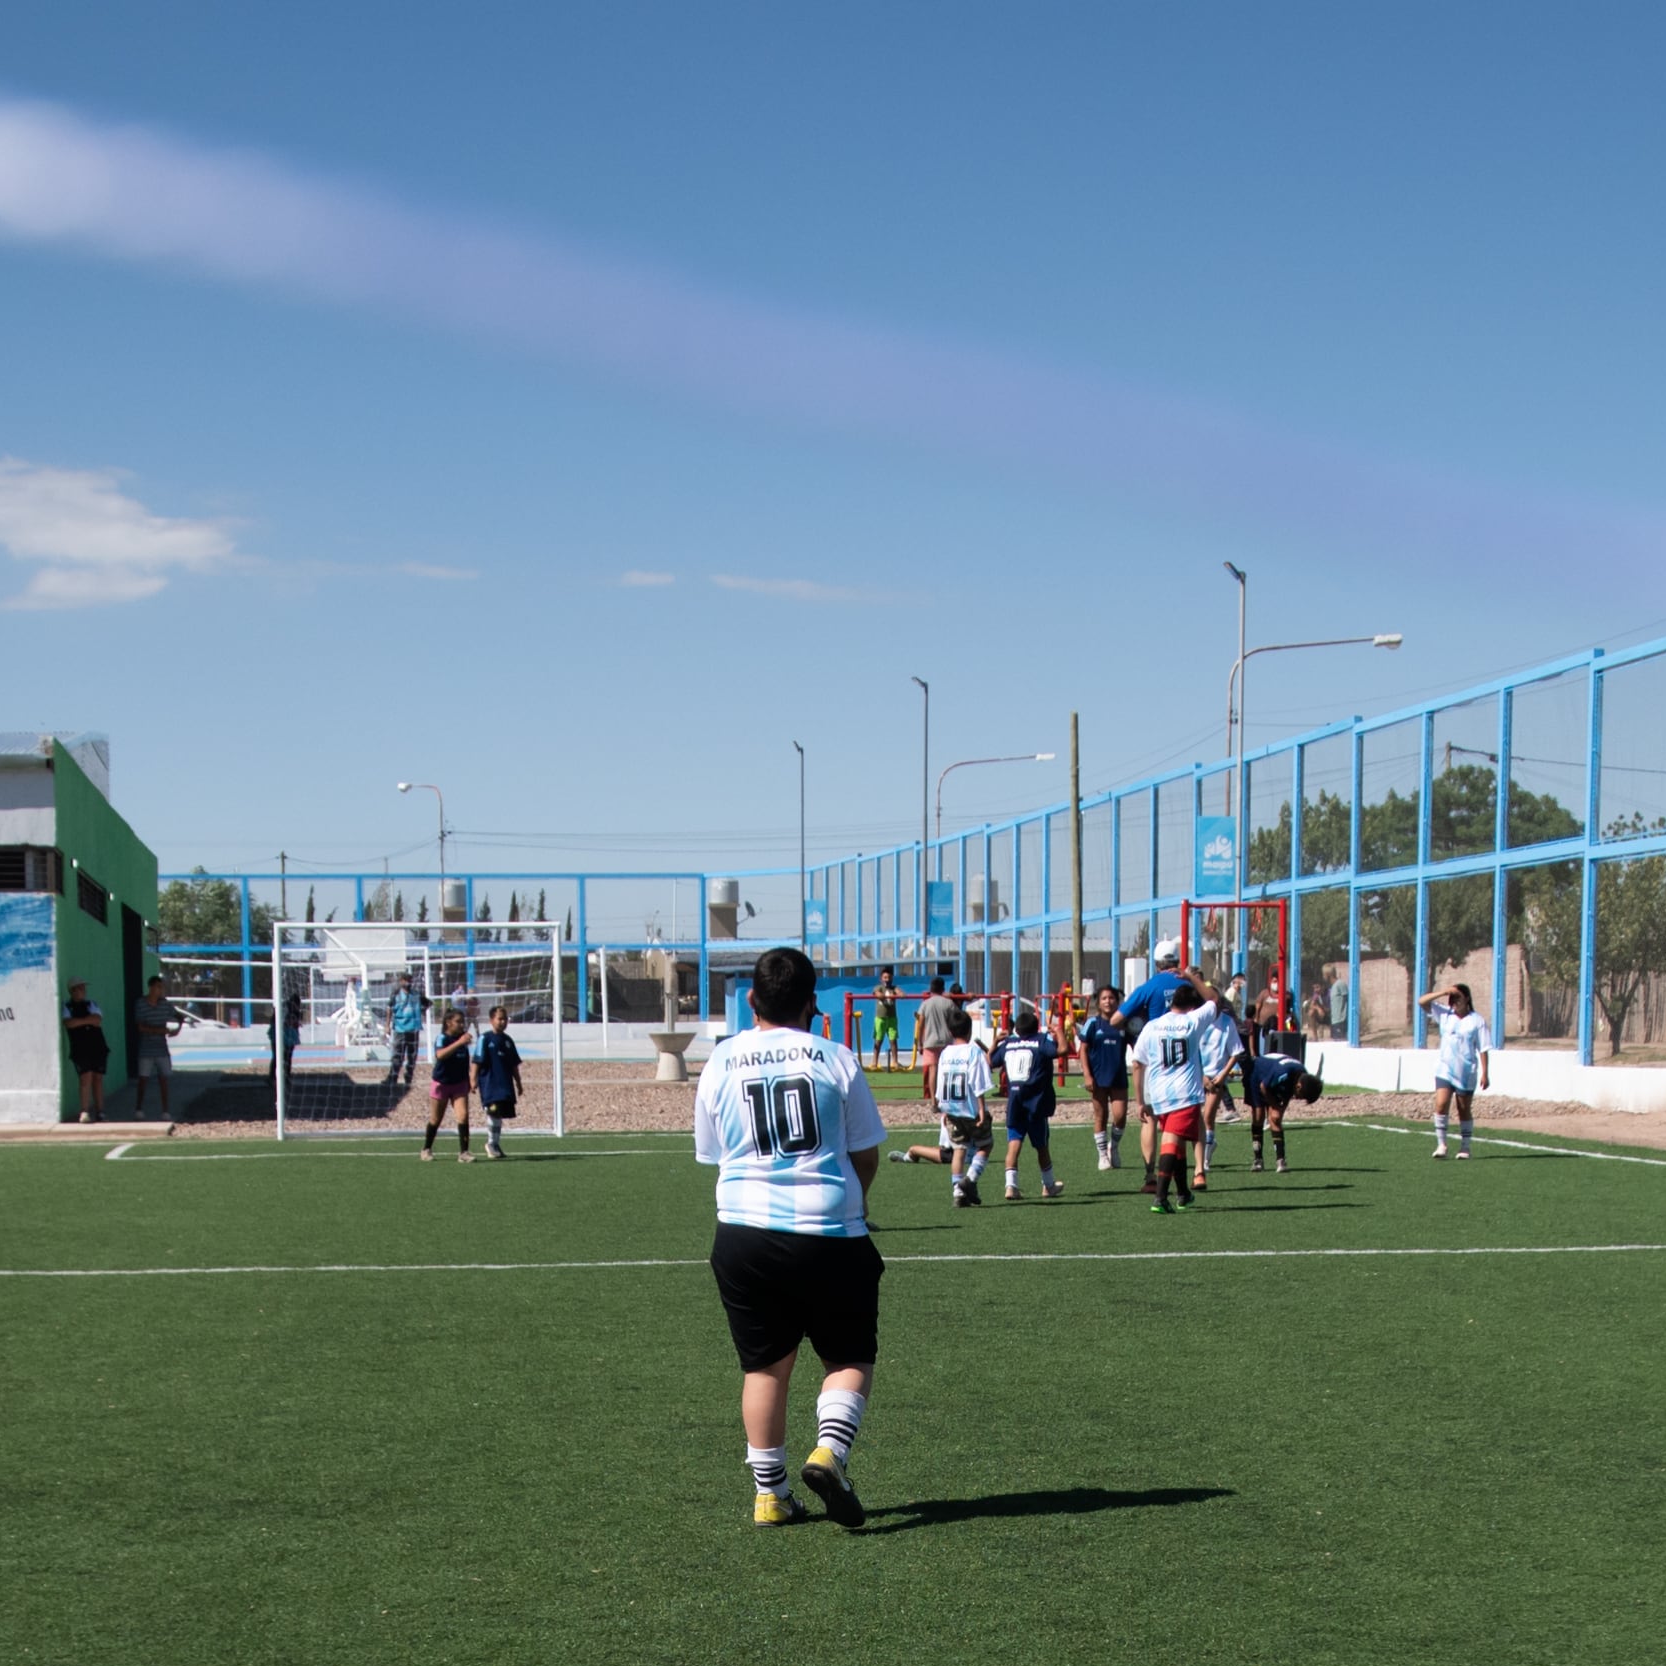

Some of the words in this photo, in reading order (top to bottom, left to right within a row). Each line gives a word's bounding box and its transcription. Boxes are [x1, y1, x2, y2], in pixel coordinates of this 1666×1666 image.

[725, 1047, 825, 1072] MARADONA
[1159, 1036, 1189, 1070] 10
[942, 1071, 969, 1103] 10
[742, 1072, 822, 1160] 10
